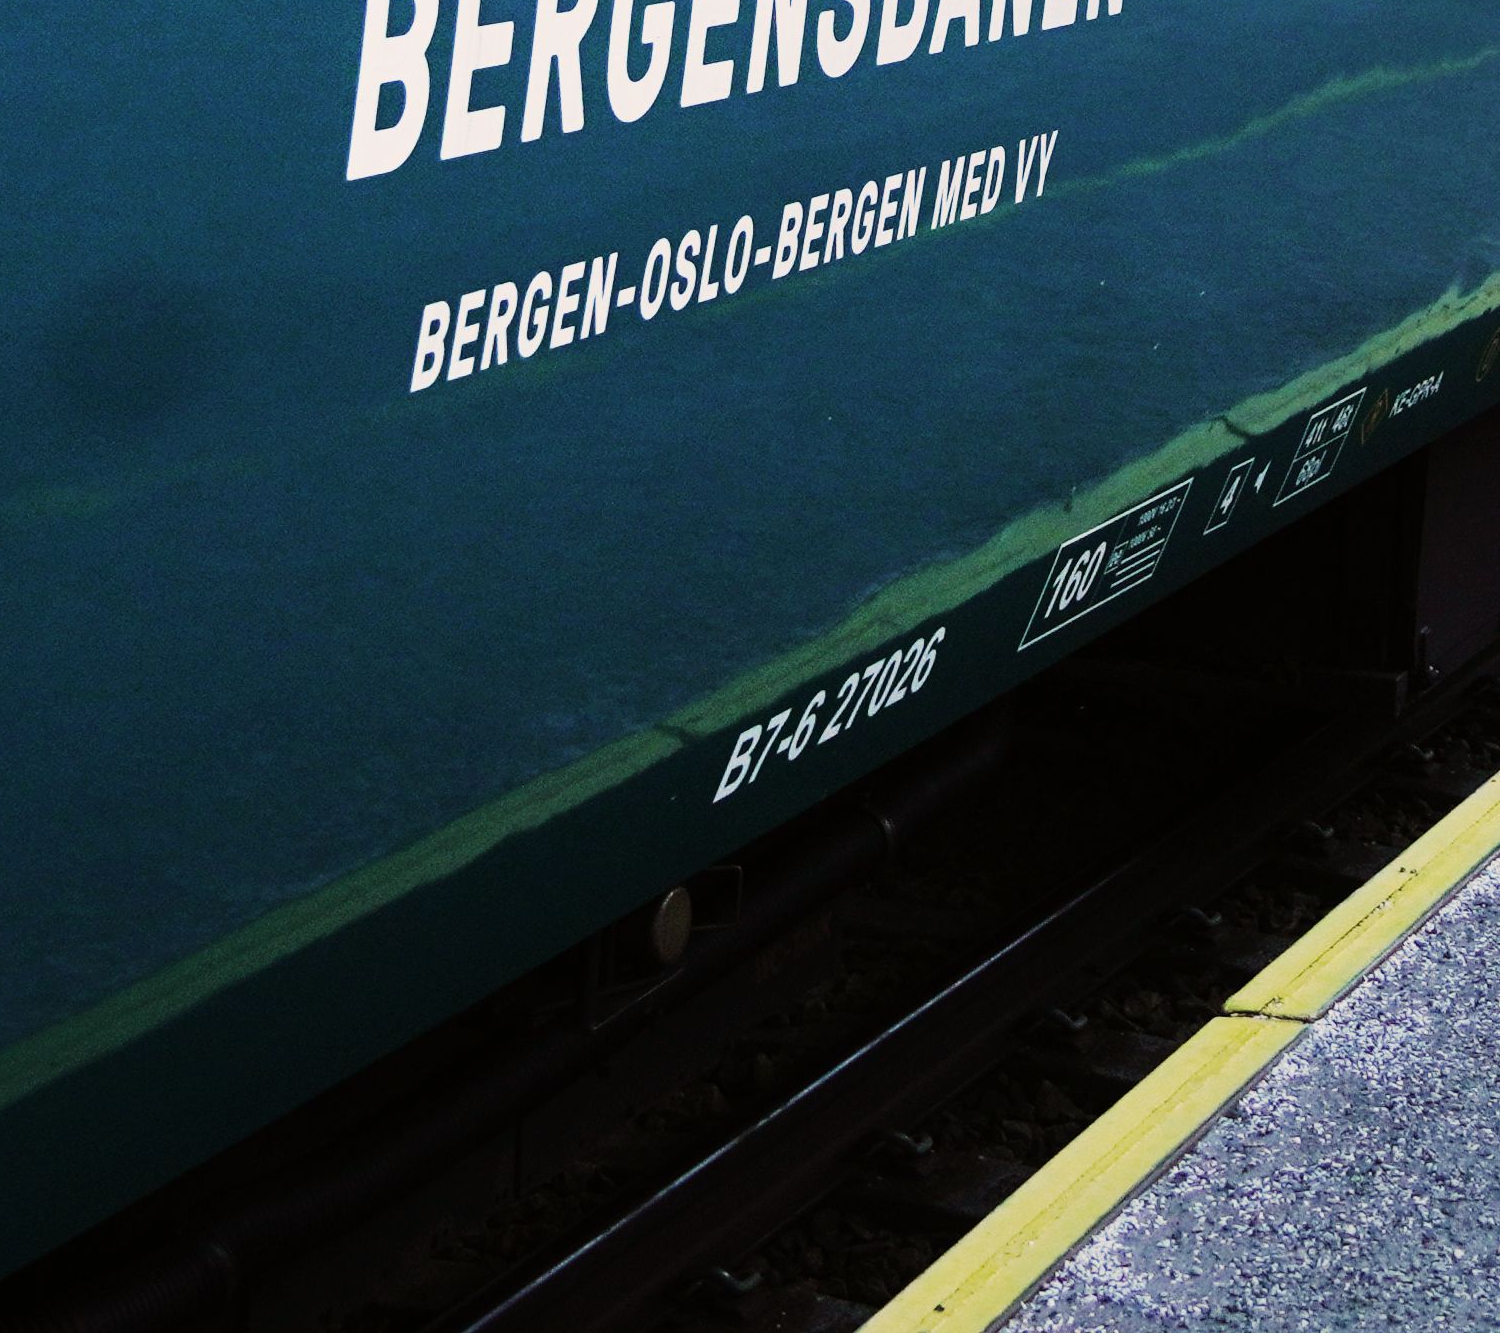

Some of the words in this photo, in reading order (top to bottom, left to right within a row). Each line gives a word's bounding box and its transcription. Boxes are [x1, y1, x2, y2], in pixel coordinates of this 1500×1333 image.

[409, 167, 927, 395] BERGEN-OSLO-BERGEN
[929, 145, 1006, 233] MED
[1011, 128, 1059, 207] VY
[1044, 541, 1107, 619] 160
[712, 689, 826, 804] B7-6
[817, 626, 946, 745] 27026
